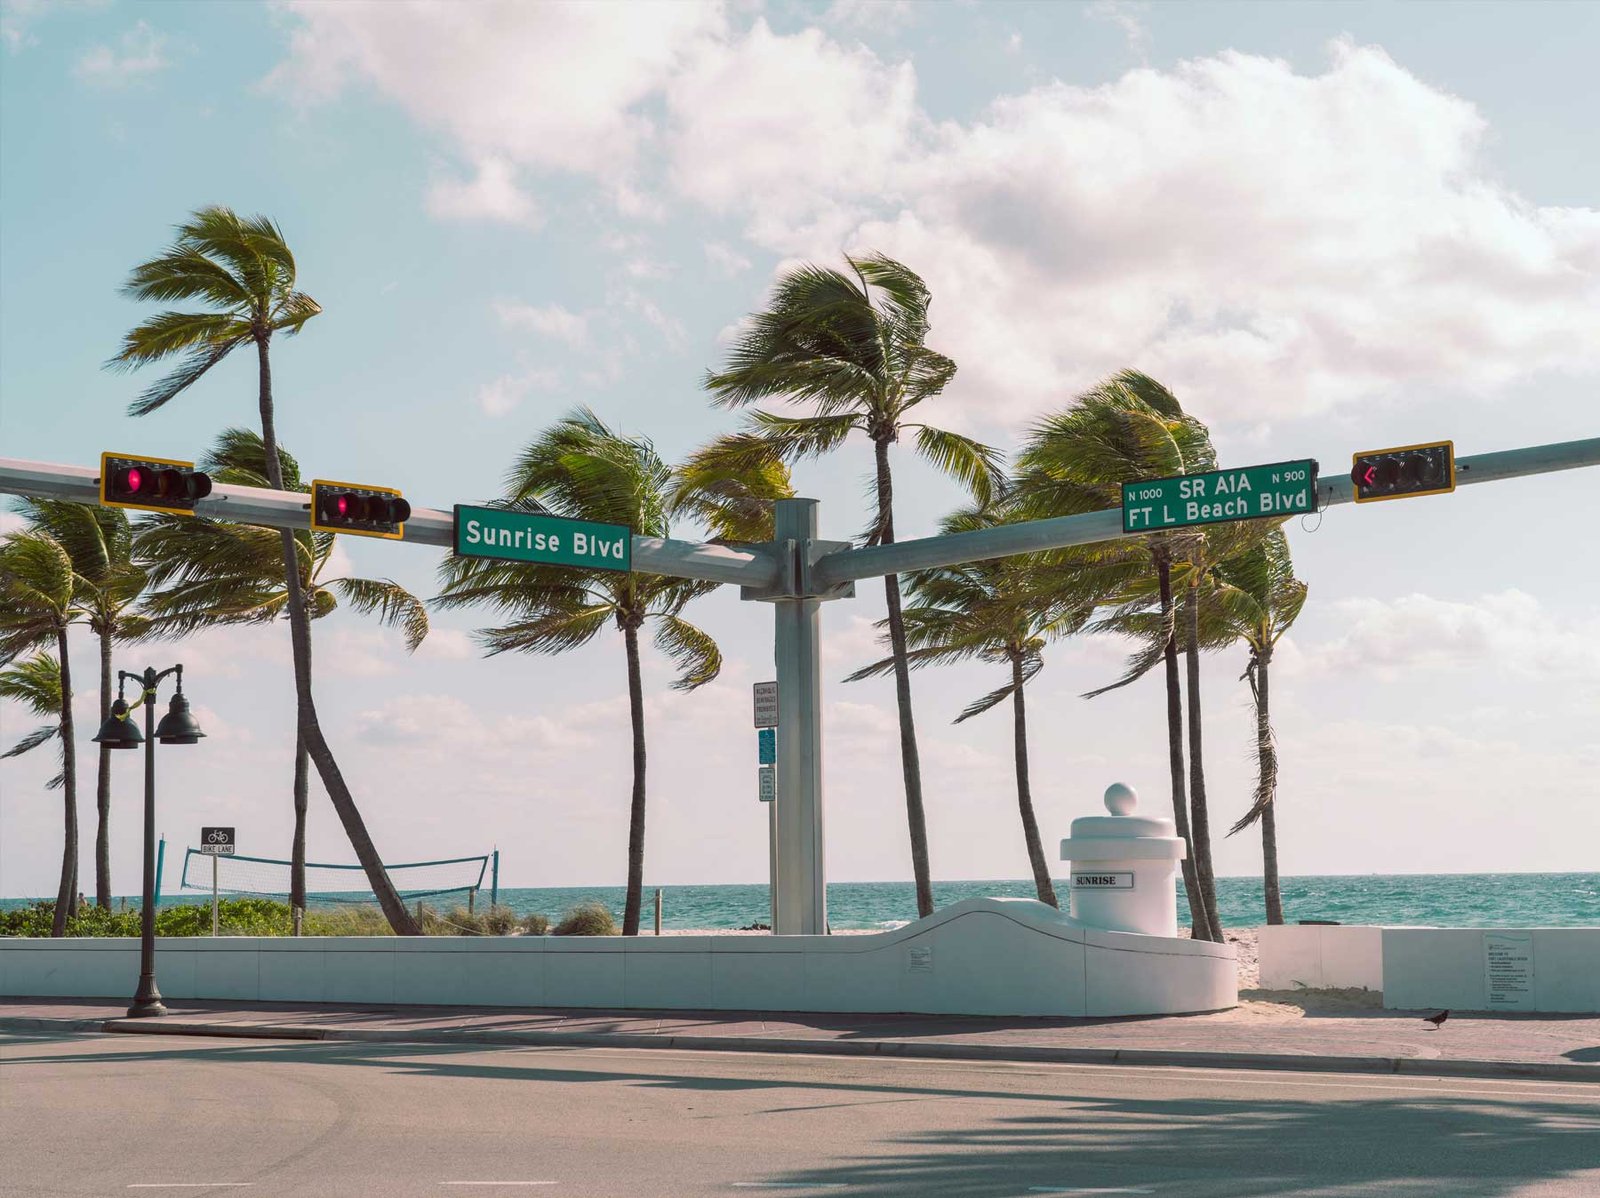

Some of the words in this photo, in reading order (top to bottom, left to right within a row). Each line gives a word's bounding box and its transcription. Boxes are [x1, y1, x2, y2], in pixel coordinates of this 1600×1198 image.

[1272, 473, 1280, 484] N
[1284, 470, 1306, 482] 900
[1179, 479, 1206, 499] SR
[1215, 473, 1252, 495] A1A
[1128, 491, 1136, 501] N
[1139, 488, 1163, 500] 1000
[1129, 507, 1152, 527] FT
[1163, 505, 1175, 523] L
[1186, 496, 1248, 520] Beach
[1260, 489, 1307, 512] Blvd
[466, 520, 560, 552] Sunrise
[573, 532, 624, 559] Blvd
[203, 845, 216, 853] BIKE
[218, 845, 232, 853] LANE
[1076, 876, 1116, 885] SUNRISE
